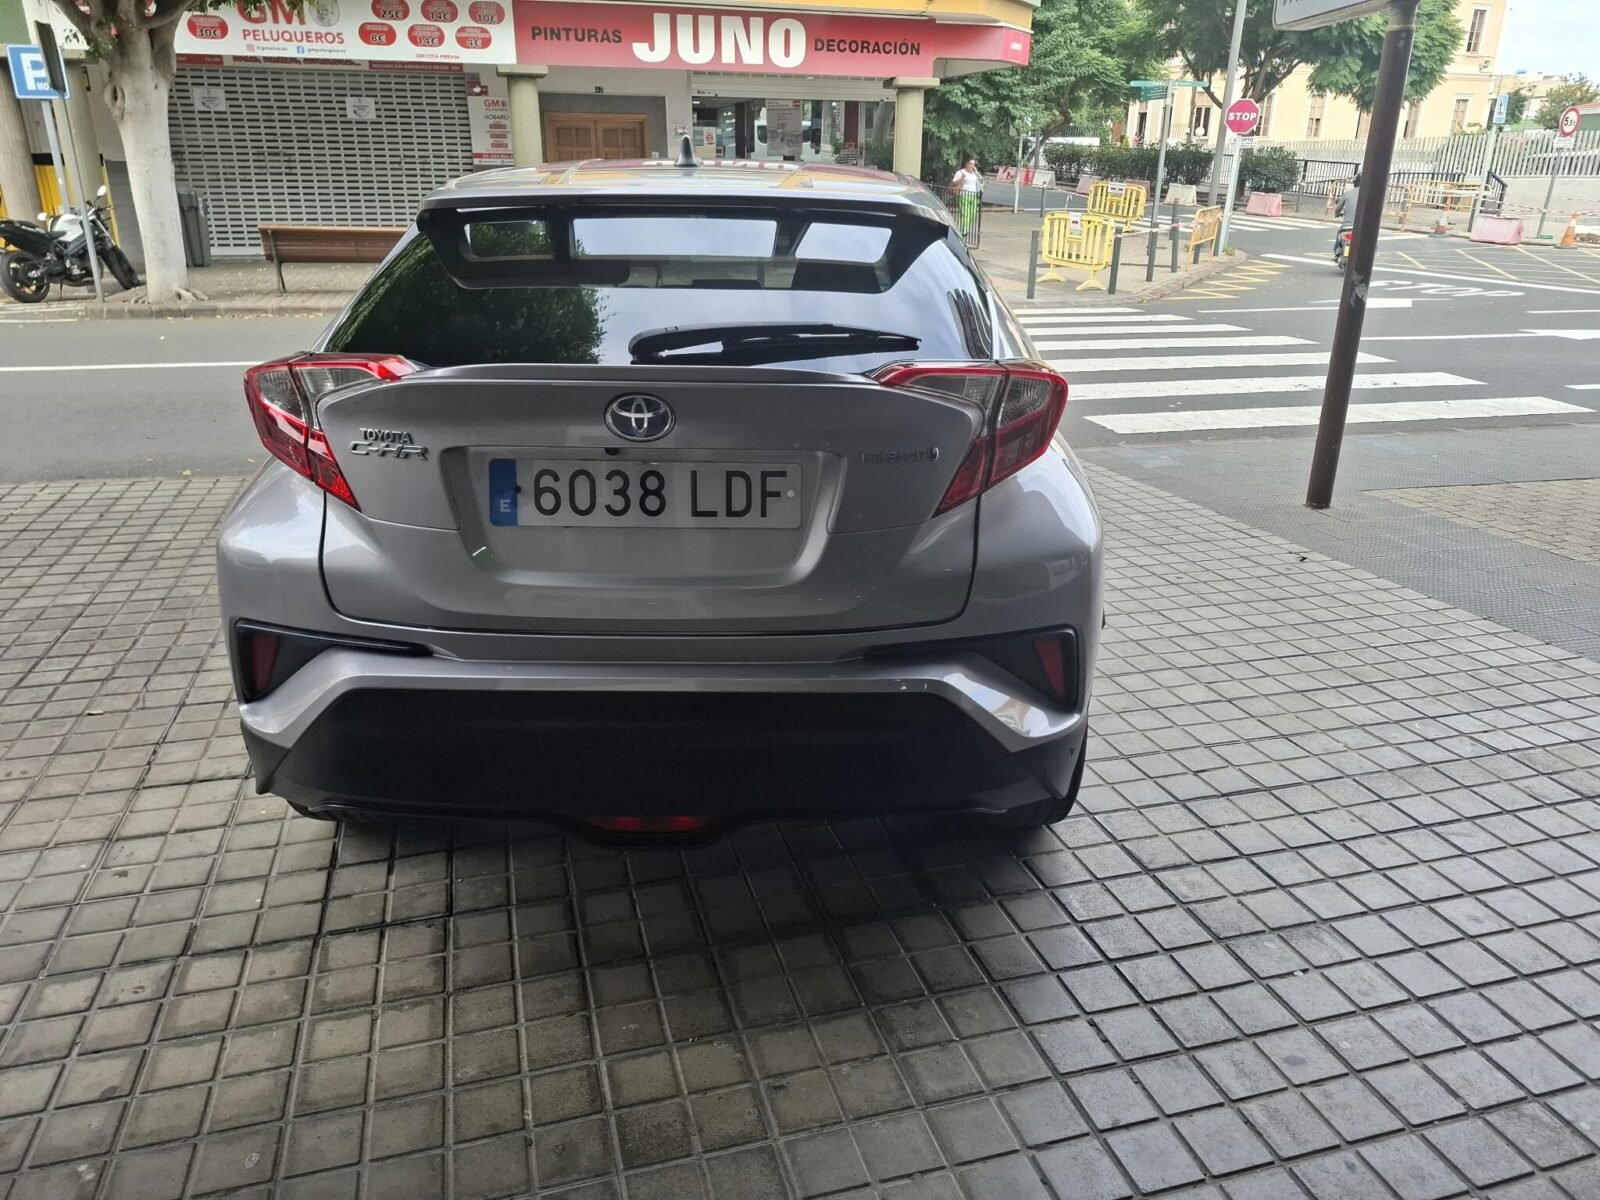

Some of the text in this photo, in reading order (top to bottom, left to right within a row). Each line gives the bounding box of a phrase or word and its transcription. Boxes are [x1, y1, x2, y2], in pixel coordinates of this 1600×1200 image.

[477, 14, 497, 23] 10€
[242, 29, 345, 45] PELUQUEROS
[371, 34, 385, 42] 8€
[417, 36, 437, 45] 14€
[468, 38, 481, 47] 4€
[531, 12, 921, 68] PINTURAS JUNO DECORACIÓN
[20, 53, 48, 90] P
[484, 99, 500, 108] GM
[1227, 112, 1257, 121] STOP
[359, 427, 415, 444] TOYOTA
[348, 441, 429, 461] C-HR
[534, 468, 788, 518] 6038 LDF
[500, 499, 511, 512] E
